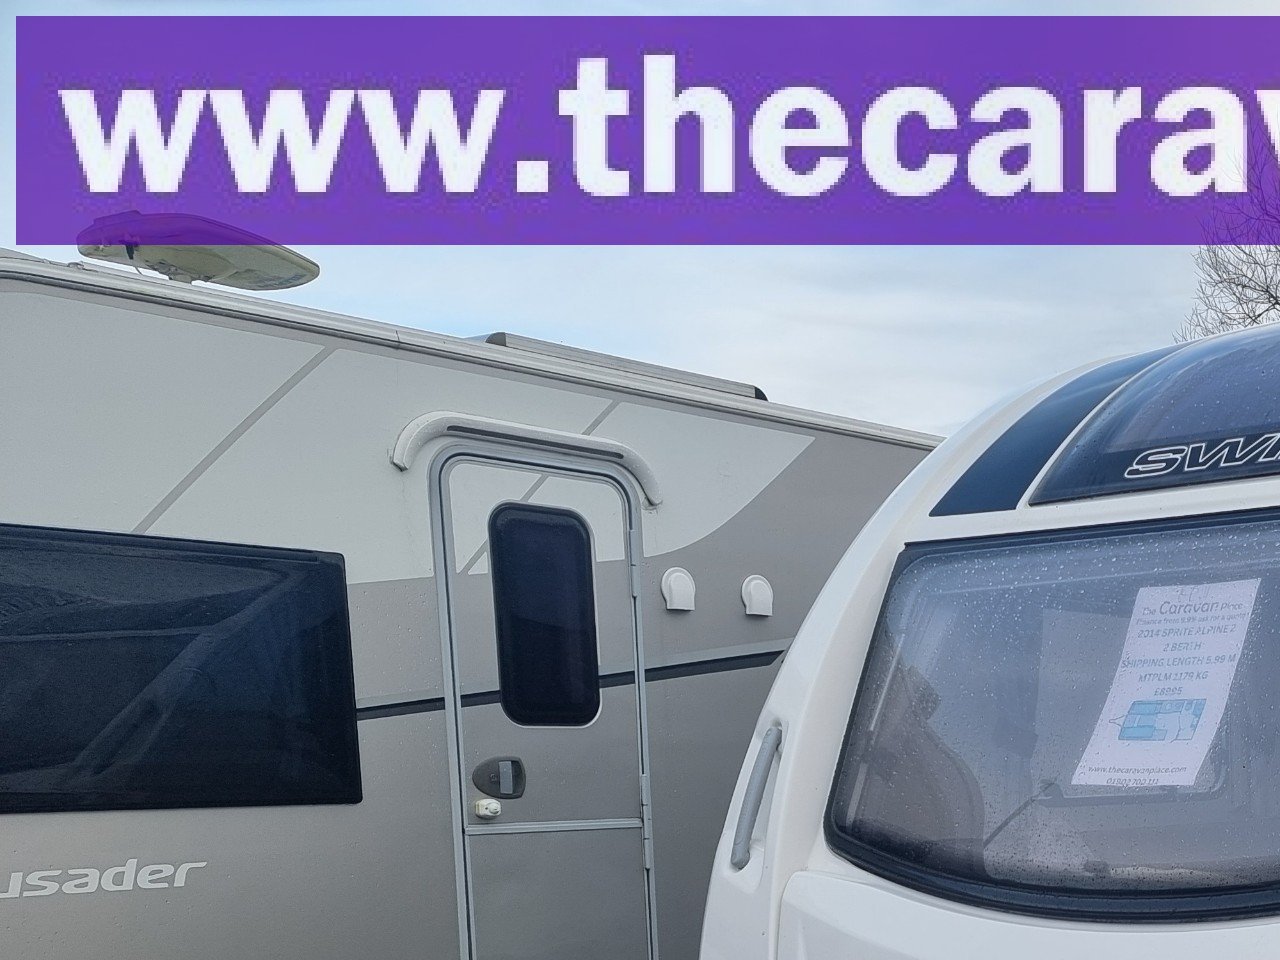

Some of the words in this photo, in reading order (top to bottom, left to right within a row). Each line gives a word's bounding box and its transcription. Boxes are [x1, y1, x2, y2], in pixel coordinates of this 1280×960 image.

[1160, 601, 1219, 615] Caravan
[1138, 629, 1160, 639] 2014
[1161, 627, 1193, 637] SPRITE
[1194, 625, 1229, 635] ALPINE
[1121, 658, 1164, 669] SHIPPING
[1166, 657, 1204, 667] LENGTH
[1195, 671, 1209, 680] KG
